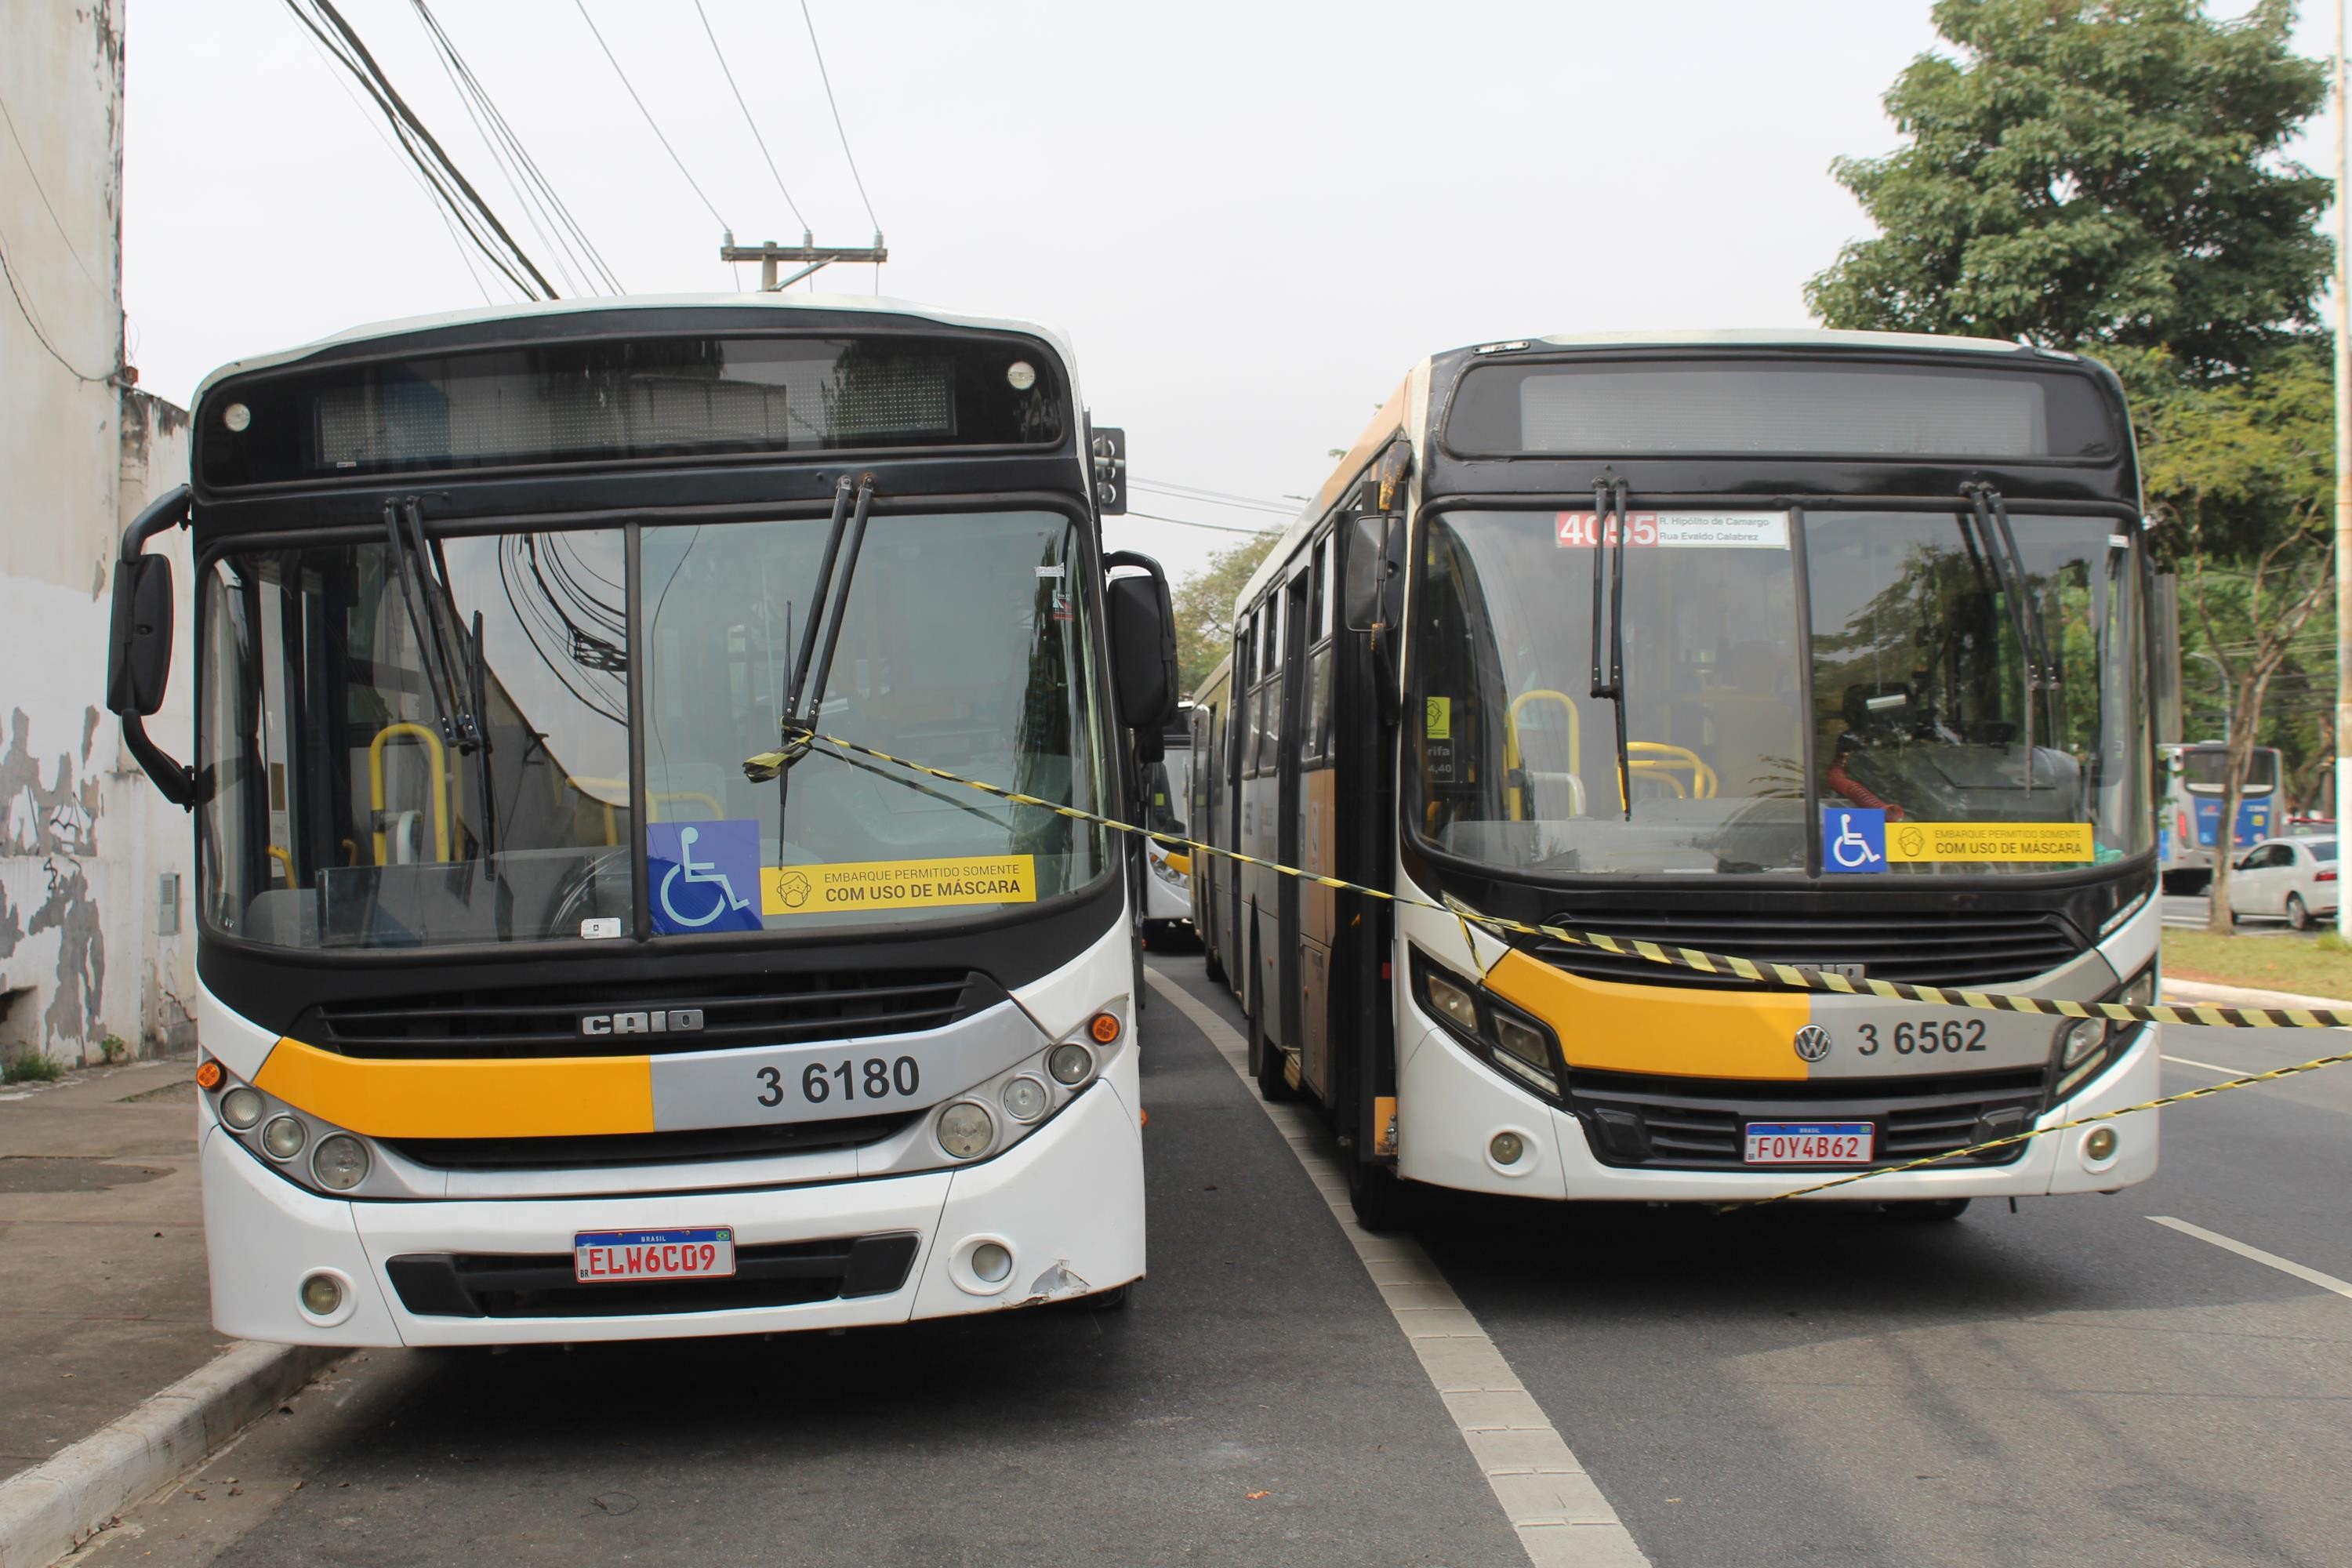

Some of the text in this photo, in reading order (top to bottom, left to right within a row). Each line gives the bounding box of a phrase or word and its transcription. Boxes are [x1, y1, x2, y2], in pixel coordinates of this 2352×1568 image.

[1560, 514, 1657, 545] 4055
[1671, 517, 1709, 526] Hipólito
[1726, 517, 1769, 528] Camargo
[1717, 532, 1759, 541] Calabrez
[1935, 829, 2082, 839] EMBARQUE PERMITIDO SOMENTE
[1936, 840, 2082, 854] COM USO DE MÁSCARA
[824, 864, 1020, 883] EMBARQUE PERMITIDO SOMENTE
[826, 879, 1021, 902] COM USO DE MÁSCARA
[583, 1009, 704, 1035] CAIO
[1857, 1019, 1987, 1055] 3 6562
[757, 1055, 920, 1107] 3 6180
[590, 1243, 716, 1275] ELW6C09
[580, 1269, 589, 1278] BR
